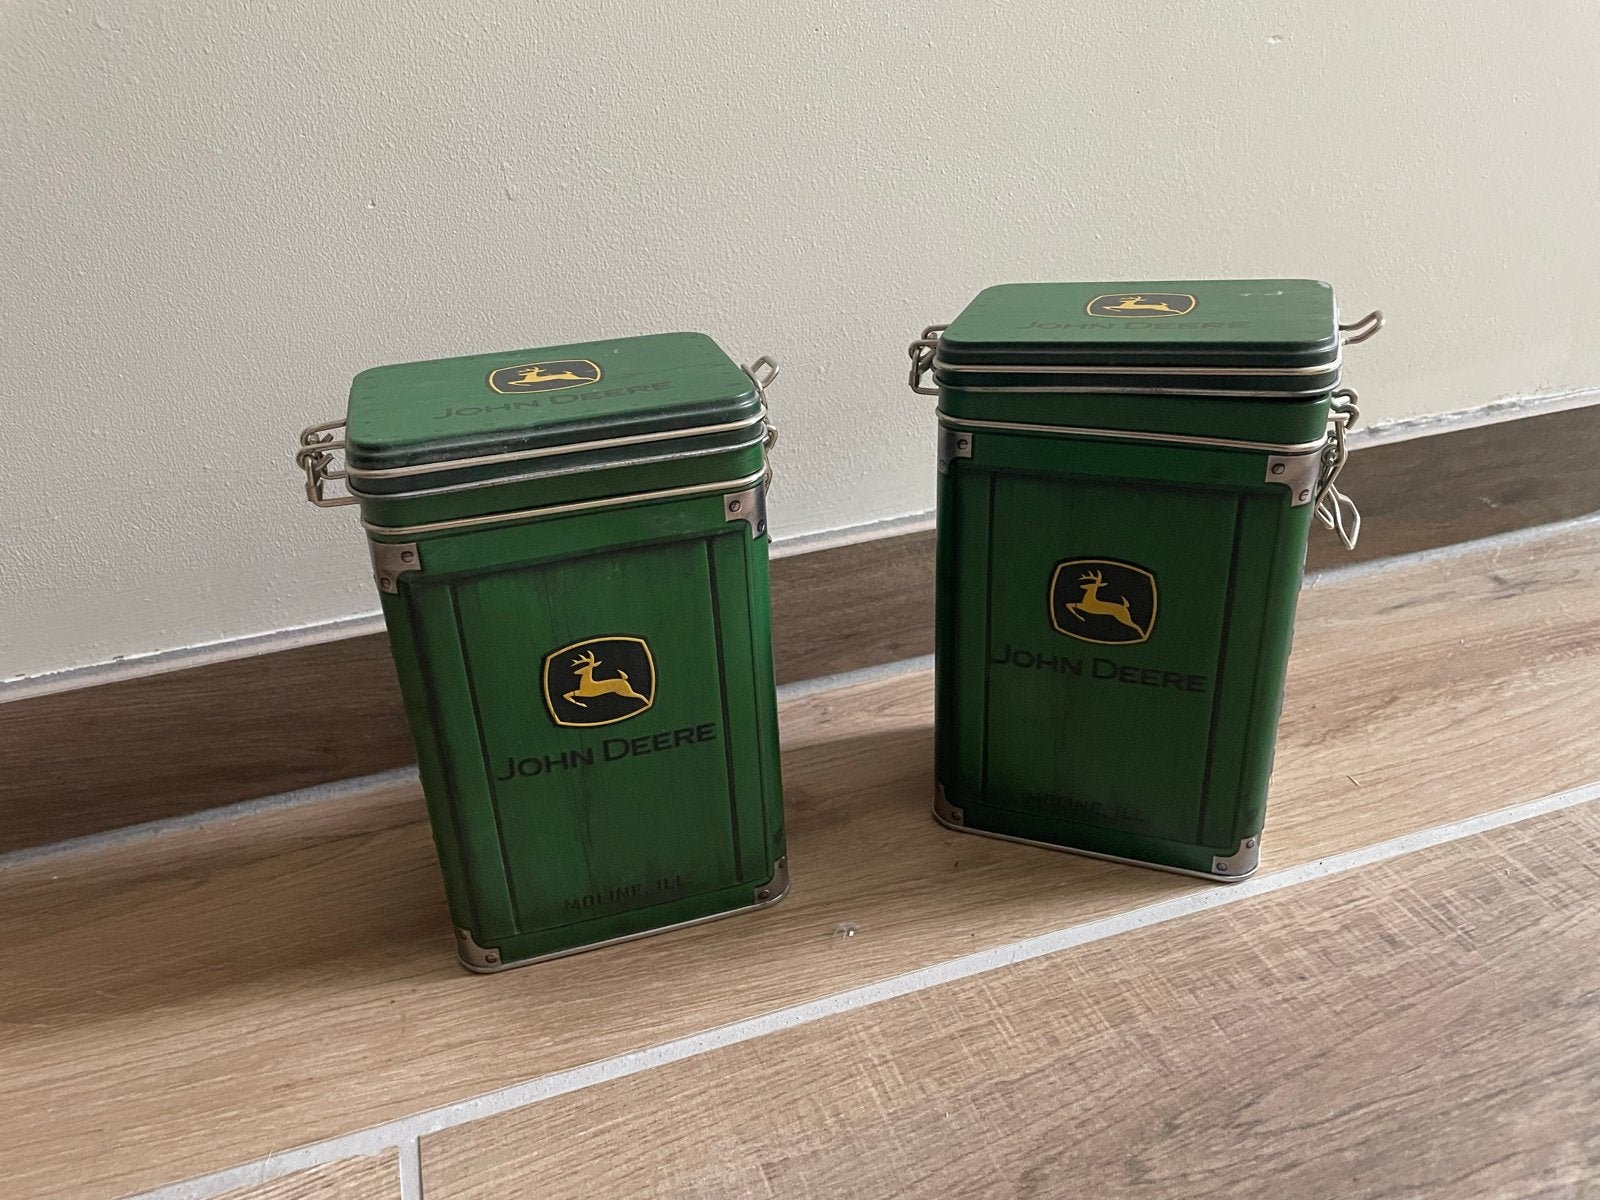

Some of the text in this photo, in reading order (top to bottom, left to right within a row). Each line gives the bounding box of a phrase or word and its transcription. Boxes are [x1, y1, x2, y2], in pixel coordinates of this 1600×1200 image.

[1016, 320, 1251, 330] JOHN DEERE
[433, 380, 675, 420] JOHN DEERE
[992, 644, 1208, 693] JOHN DEERE
[497, 722, 717, 781] JOHN DEERE
